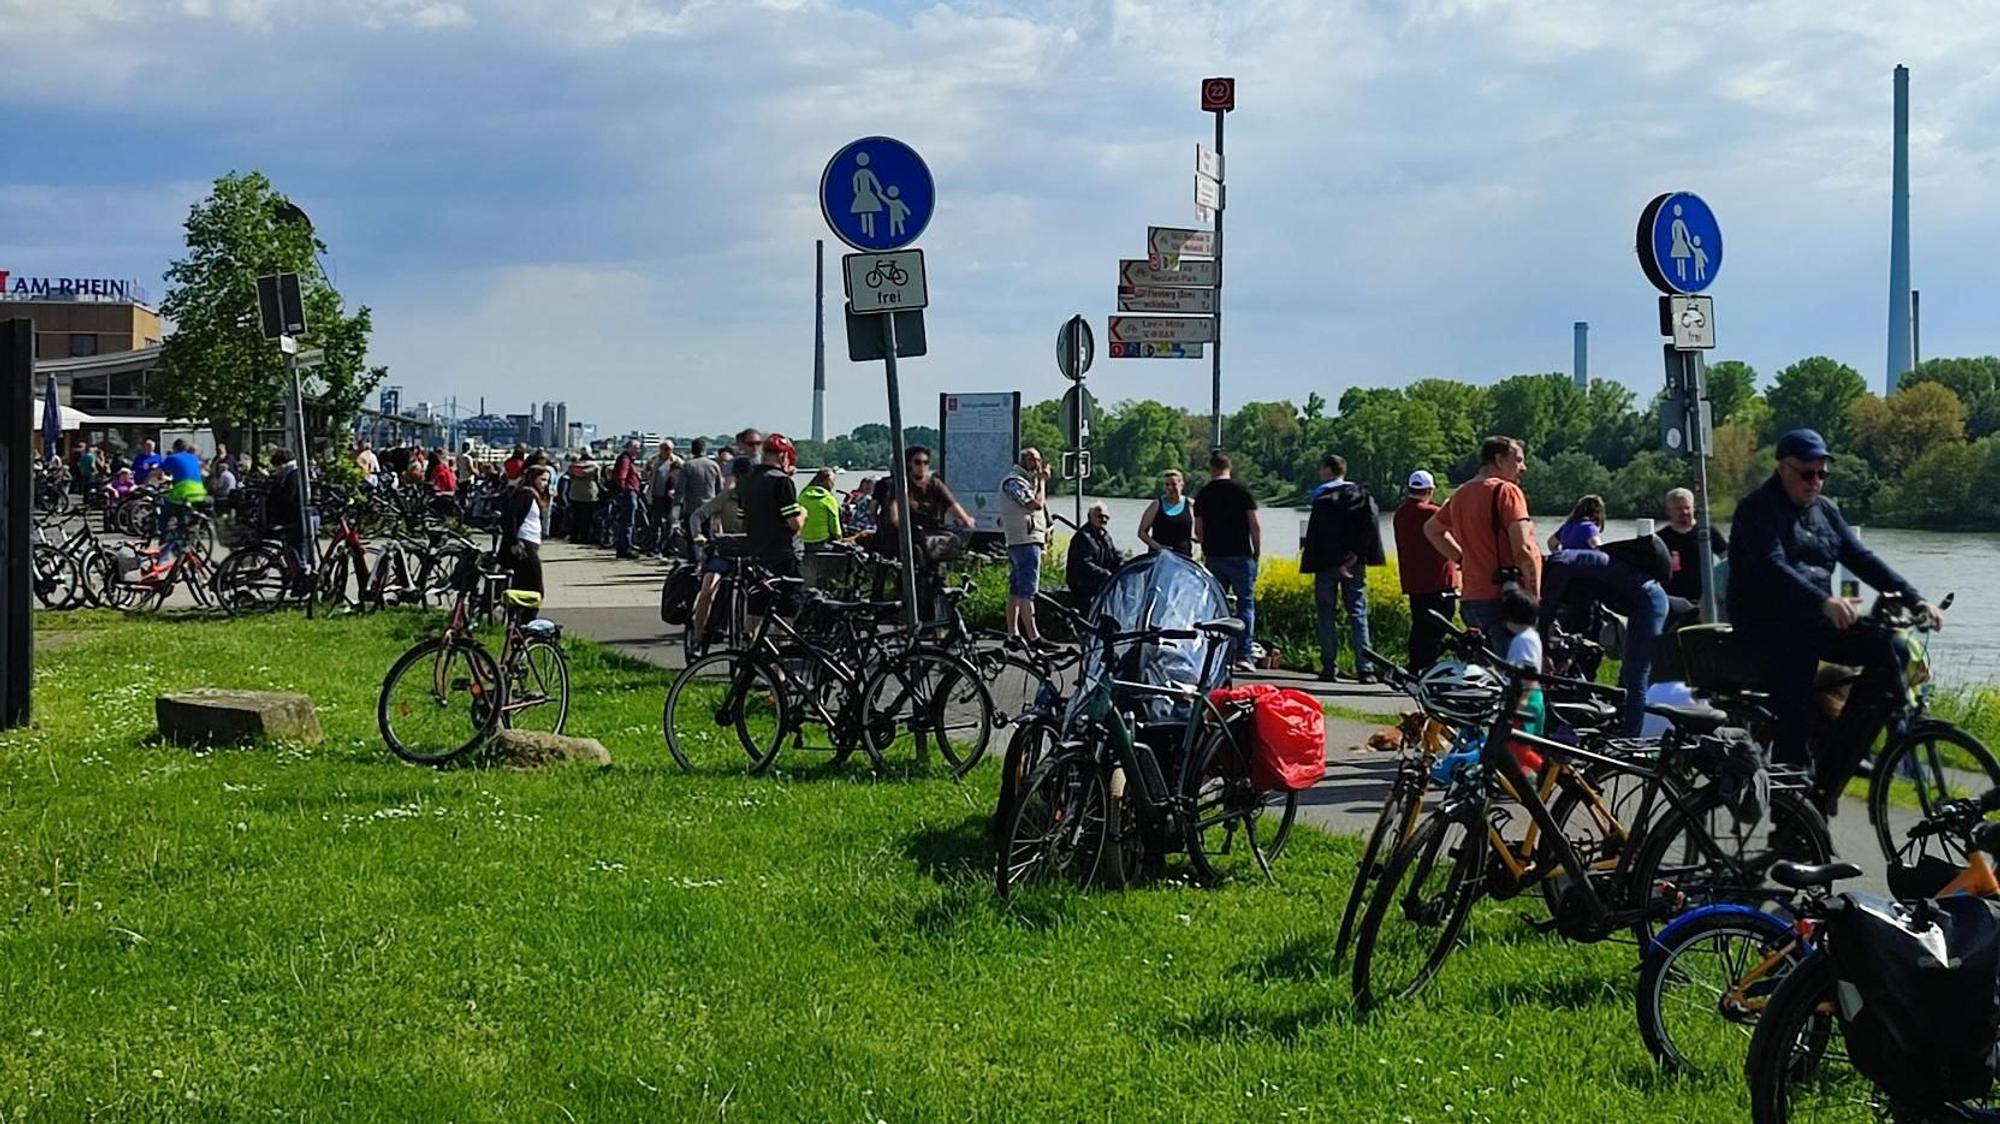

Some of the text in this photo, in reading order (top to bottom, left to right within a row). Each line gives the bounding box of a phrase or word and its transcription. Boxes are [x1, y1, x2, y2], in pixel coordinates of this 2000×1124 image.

[1211, 85, 1224, 97] 22
[13, 278, 49, 295] AM
[59, 278, 124, 297] RHEIN
[877, 290, 901, 304] frei
